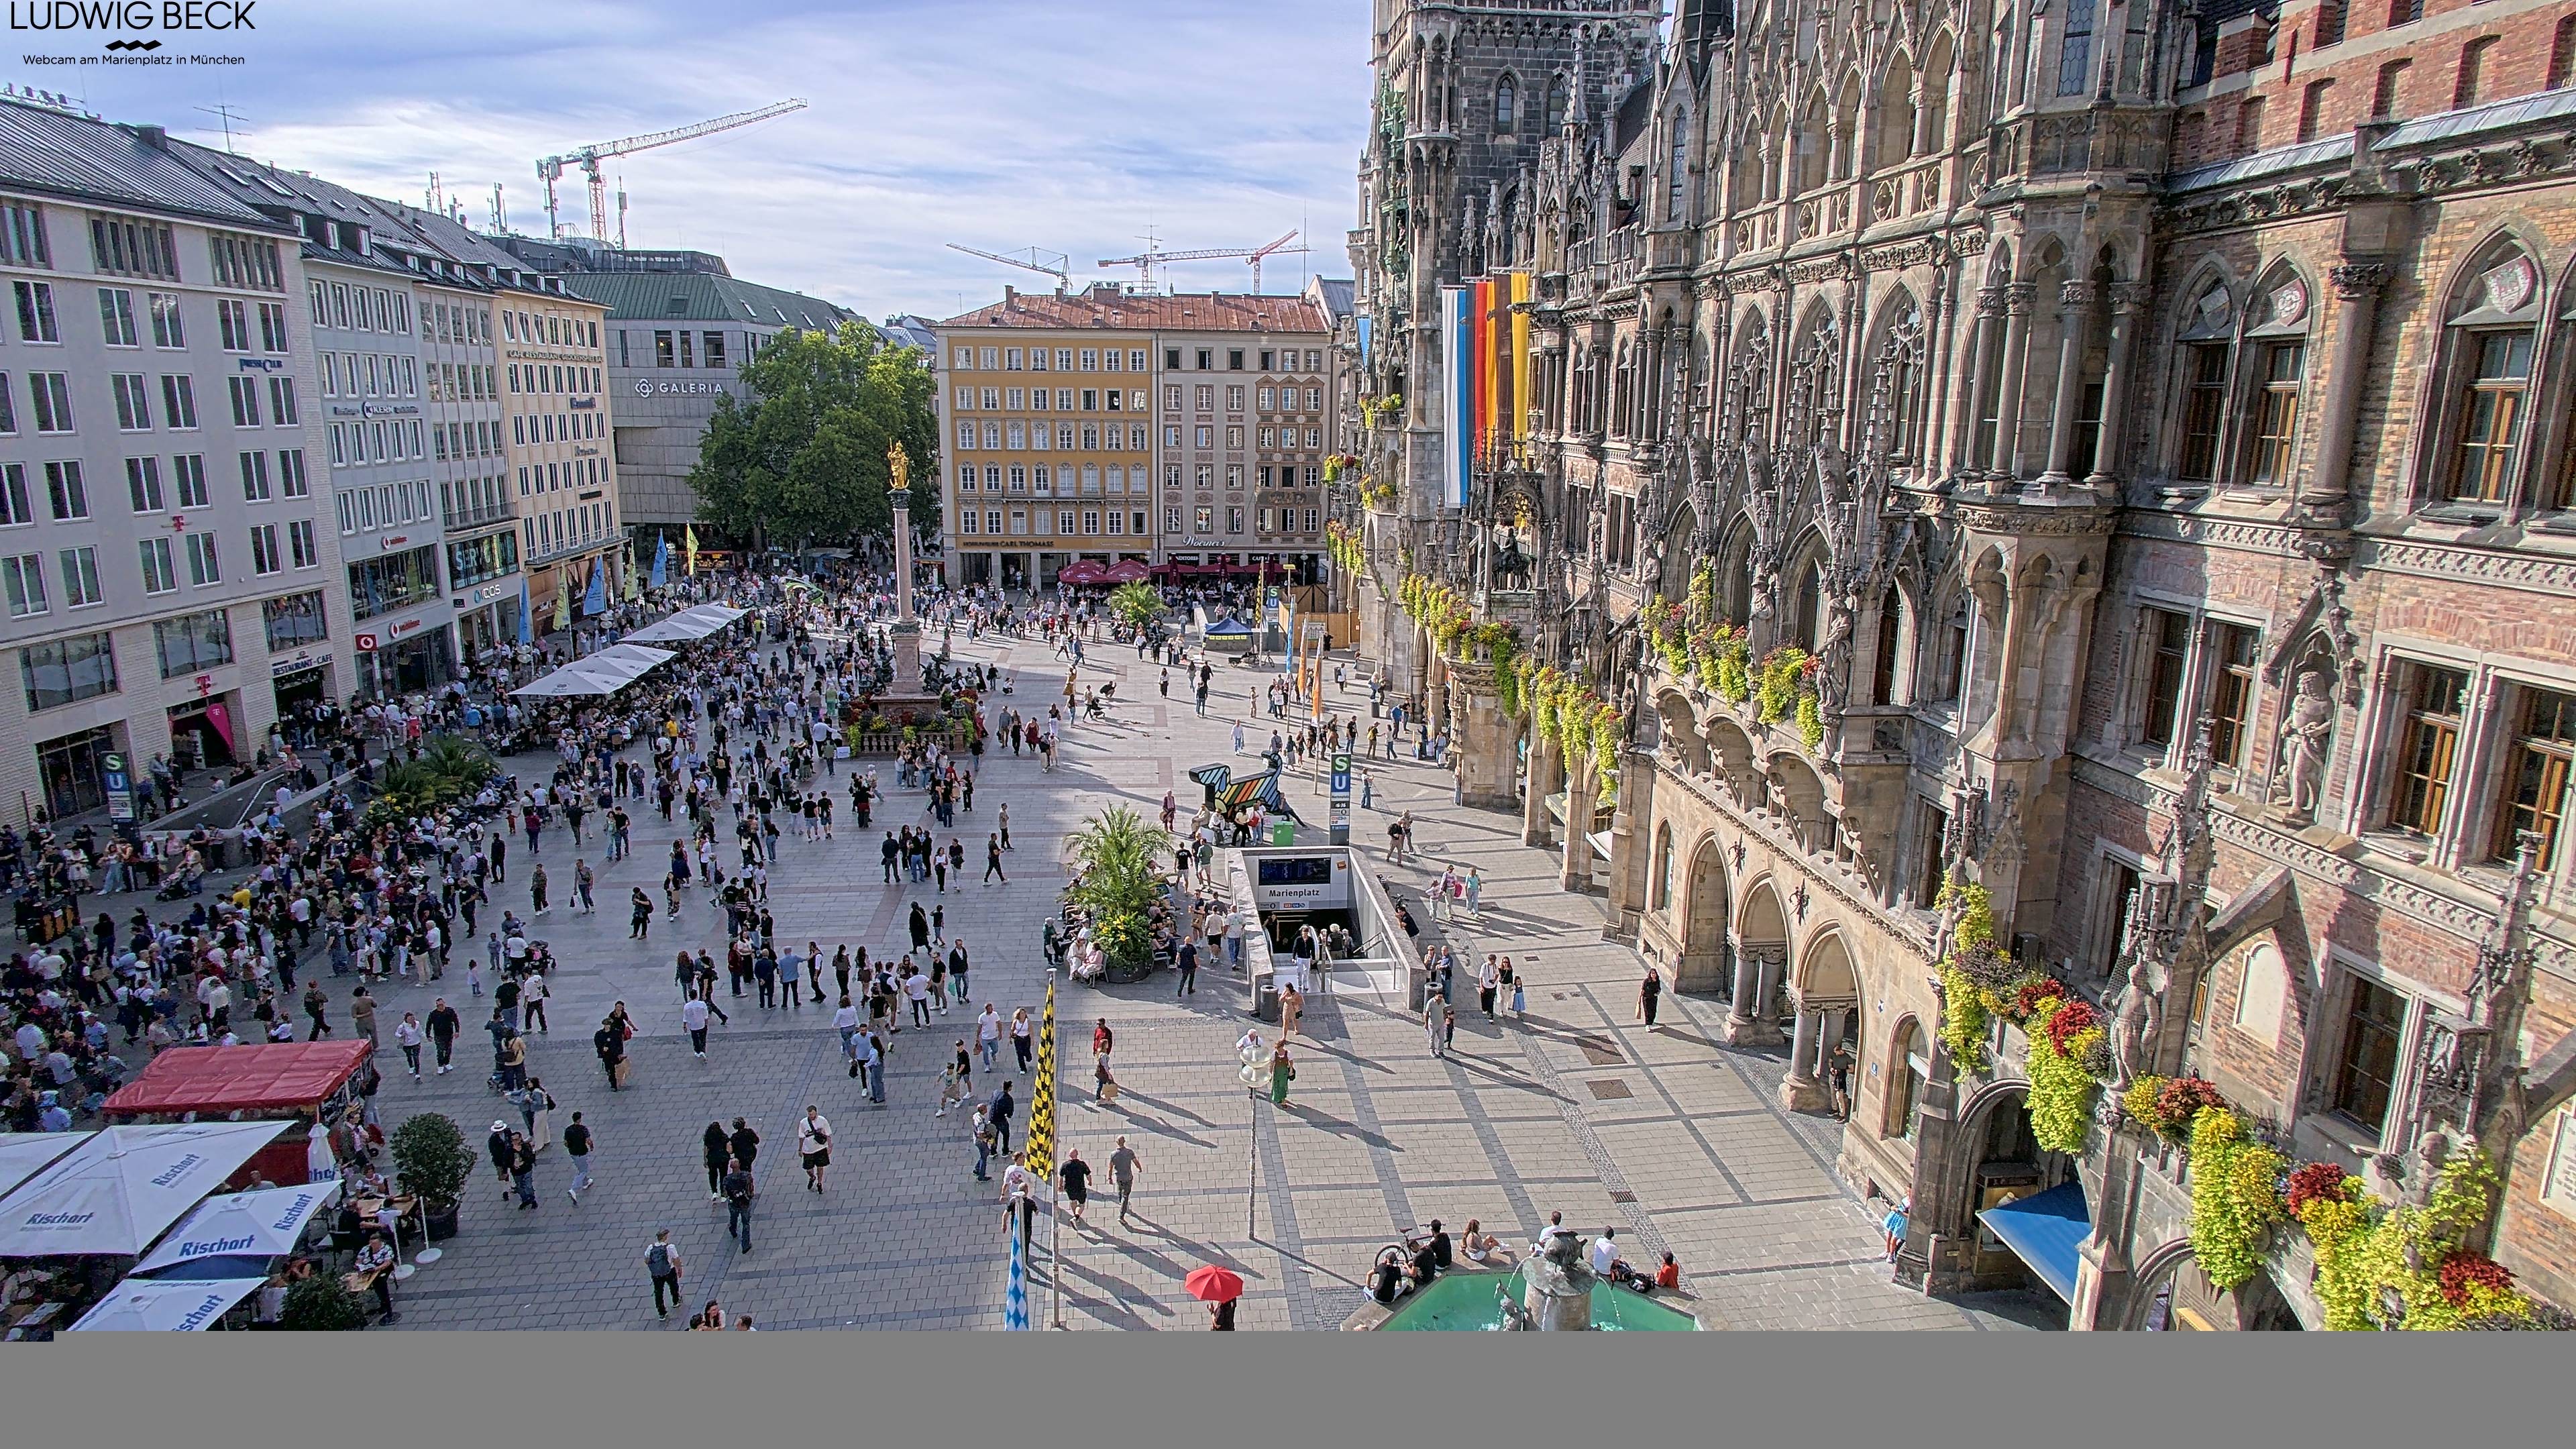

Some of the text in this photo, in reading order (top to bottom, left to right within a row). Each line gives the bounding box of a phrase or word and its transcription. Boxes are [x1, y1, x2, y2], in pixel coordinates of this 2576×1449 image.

[659, 383, 723, 393] GALERIA
[1183, 535, 1225, 547] Woerner's
[1270, 588, 1278, 597] S
[1270, 598, 1277, 607] U
[106, 755, 121, 770] S
[1335, 756, 1348, 771] S
[109, 774, 123, 789] U
[1335, 775, 1346, 790] U
[1269, 889, 1320, 898] Marienplatz
[150, 1153, 200, 1186] Rischart
[25, 1212, 95, 1225] Rischart
[273, 1193, 313, 1232] Rischart
[179, 1234, 255, 1256] Rischart
